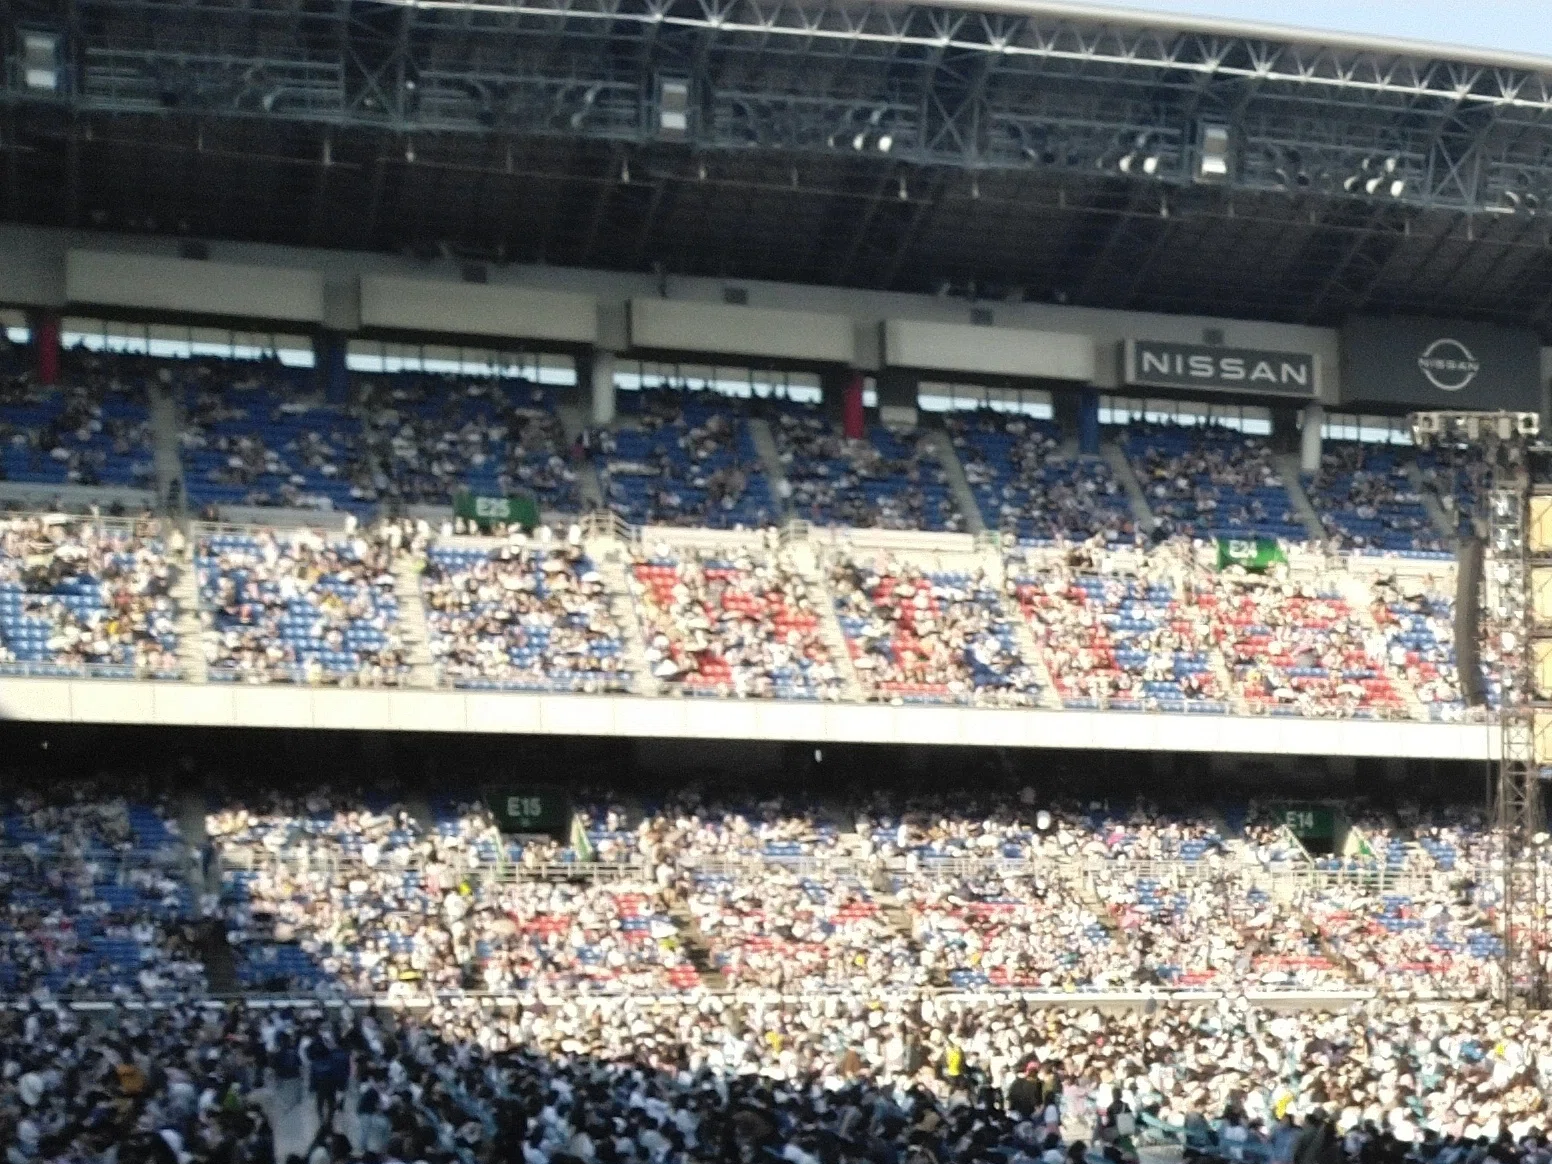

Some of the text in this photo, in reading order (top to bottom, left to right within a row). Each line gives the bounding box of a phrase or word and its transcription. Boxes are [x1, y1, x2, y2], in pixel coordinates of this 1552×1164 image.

[1142, 351, 1307, 385] NISSAN
[1418, 358, 1480, 371] NISSAN
[475, 497, 510, 519] E25
[507, 797, 542, 817] E15
[1286, 811, 1314, 829] E14
